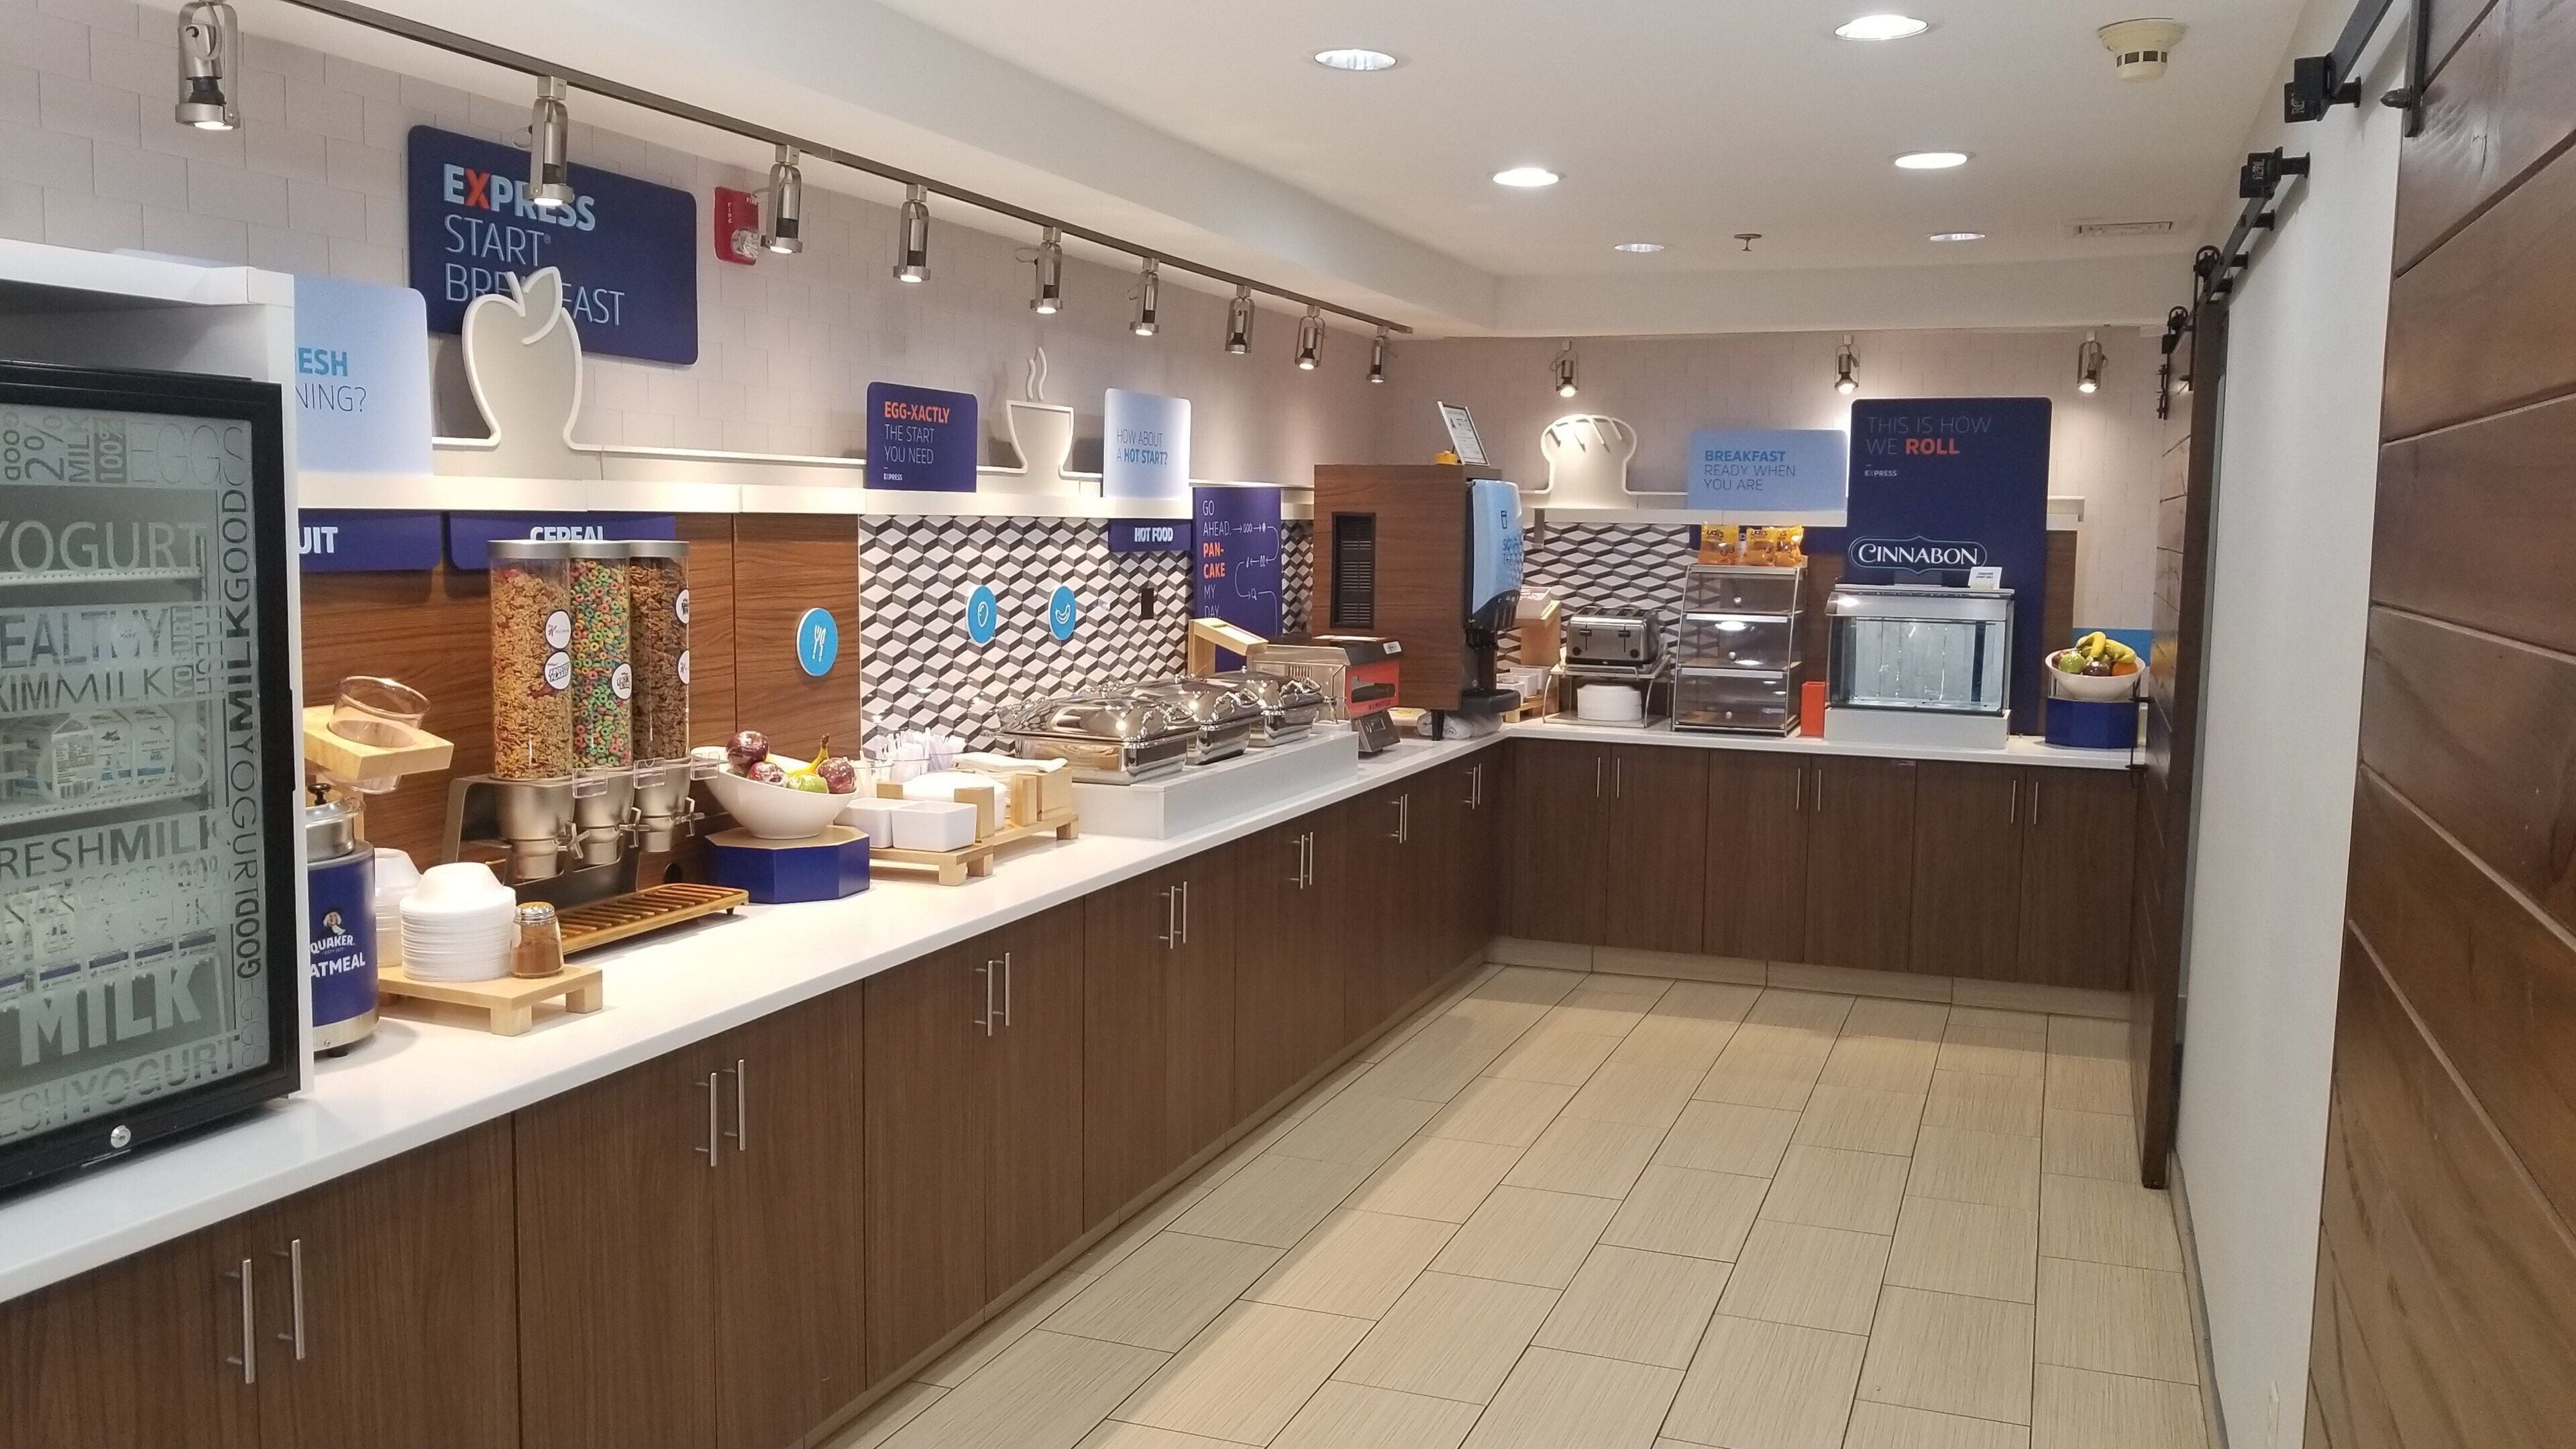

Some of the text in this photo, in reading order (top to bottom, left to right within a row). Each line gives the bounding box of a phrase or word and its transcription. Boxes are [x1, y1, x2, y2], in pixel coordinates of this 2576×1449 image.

[445, 262, 625, 325] BREAST
[294, 347, 348, 377] ESH
[884, 400, 951, 424] EGG-XACTLY
[1868, 416, 1992, 433] THIS IS HOW
[884, 424, 934, 443] THE START
[1116, 428, 1163, 447] HOW ABOUT
[883, 445, 934, 464] YOU NEED
[1866, 438, 1961, 455] WE ROLL
[1116, 447, 1168, 465] A HOT START?
[1705, 450, 1786, 462] BREAKFAST
[1704, 464, 1795, 477] READY WHEN
[1704, 478, 1763, 491] YOU ARE
[1203, 500, 1214, 516] GO
[1134, 527, 1173, 542] HOT FOOD
[1203, 541, 1224, 557] PAN-
[1858, 543, 1979, 565] CINNABON
[1203, 562, 1226, 579] CAKE
[1204, 584, 1216, 600] MY
[310, 934, 354, 955] QUAKER
[19, 958, 202, 1066] MILK
